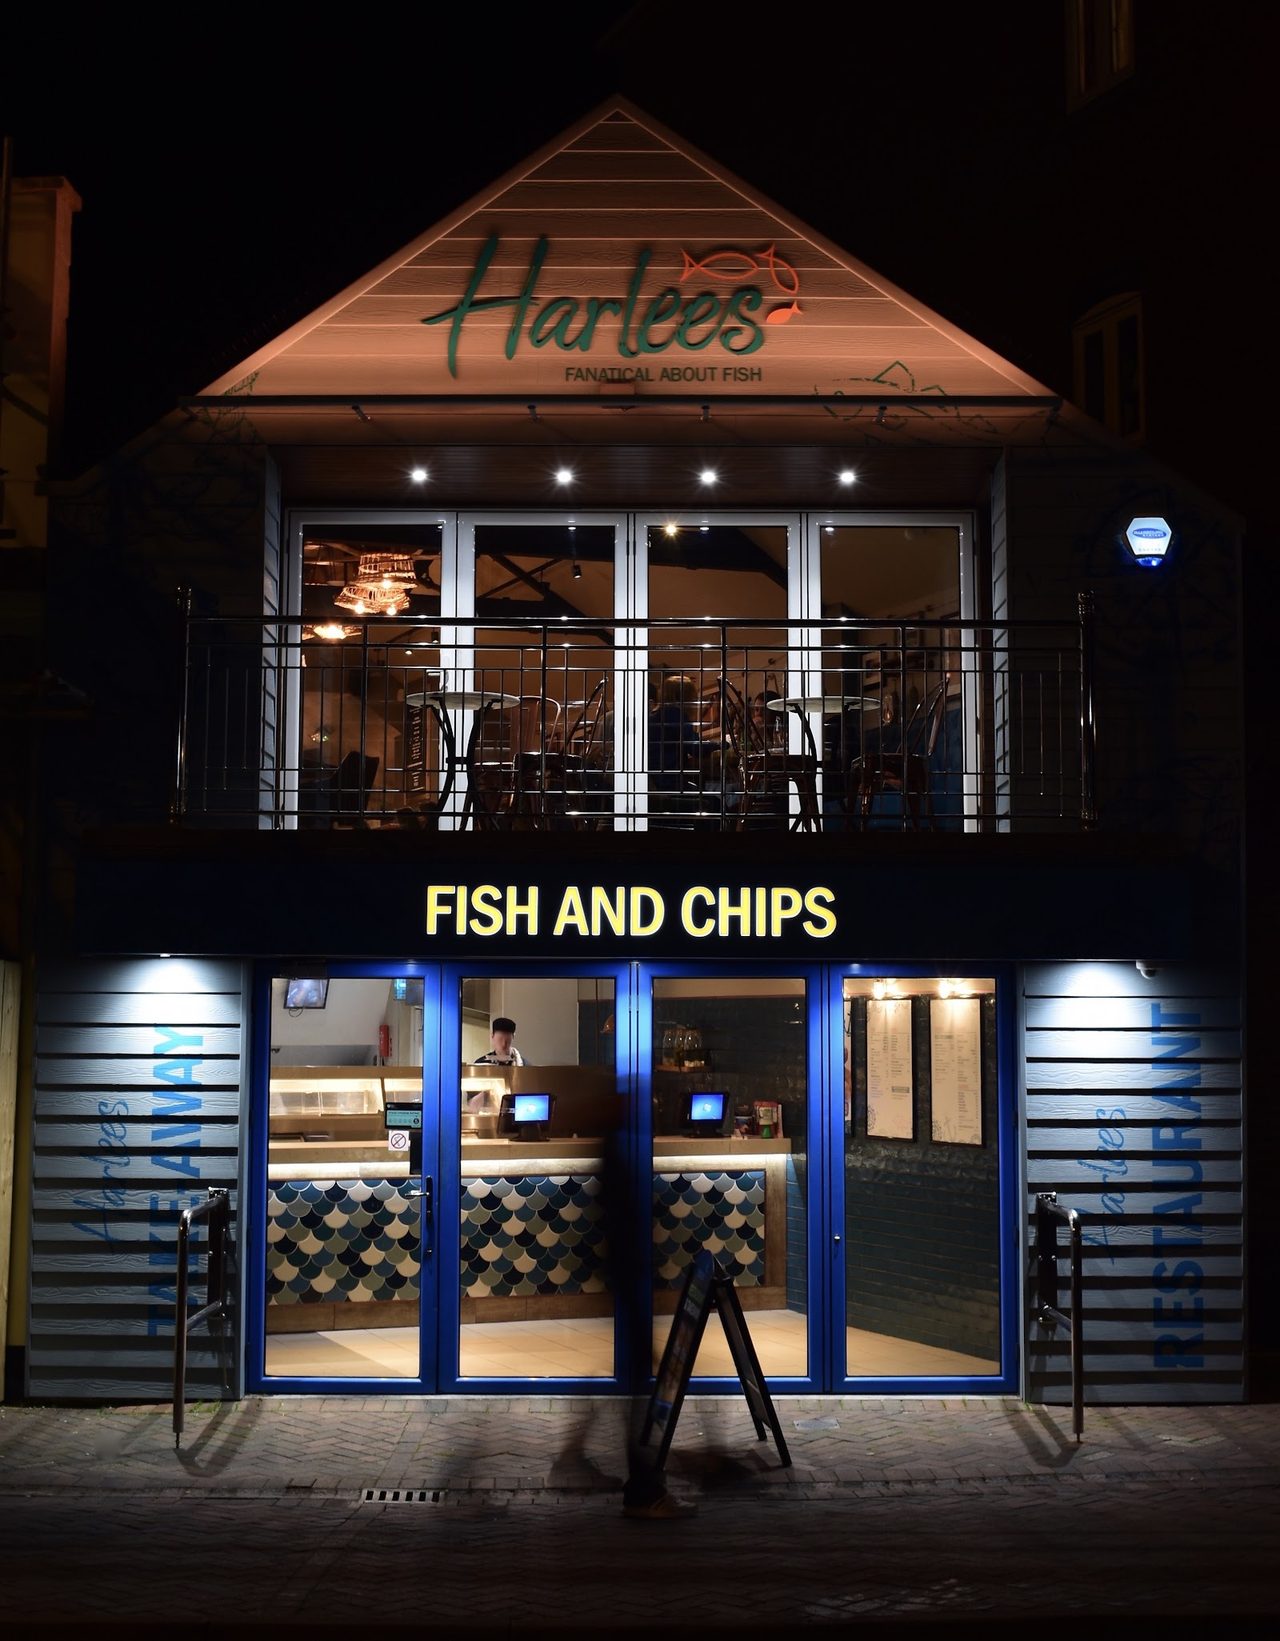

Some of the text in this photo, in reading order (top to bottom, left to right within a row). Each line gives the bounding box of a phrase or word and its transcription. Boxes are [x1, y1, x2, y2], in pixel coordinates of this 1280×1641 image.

[420, 234, 765, 381] Harlees
[564, 367, 762, 382] FANATICAL ABOUT FISH
[425, 885, 838, 939] FISH AND CHIPS
[1151, 1003, 1204, 1368] RESTAURANT
